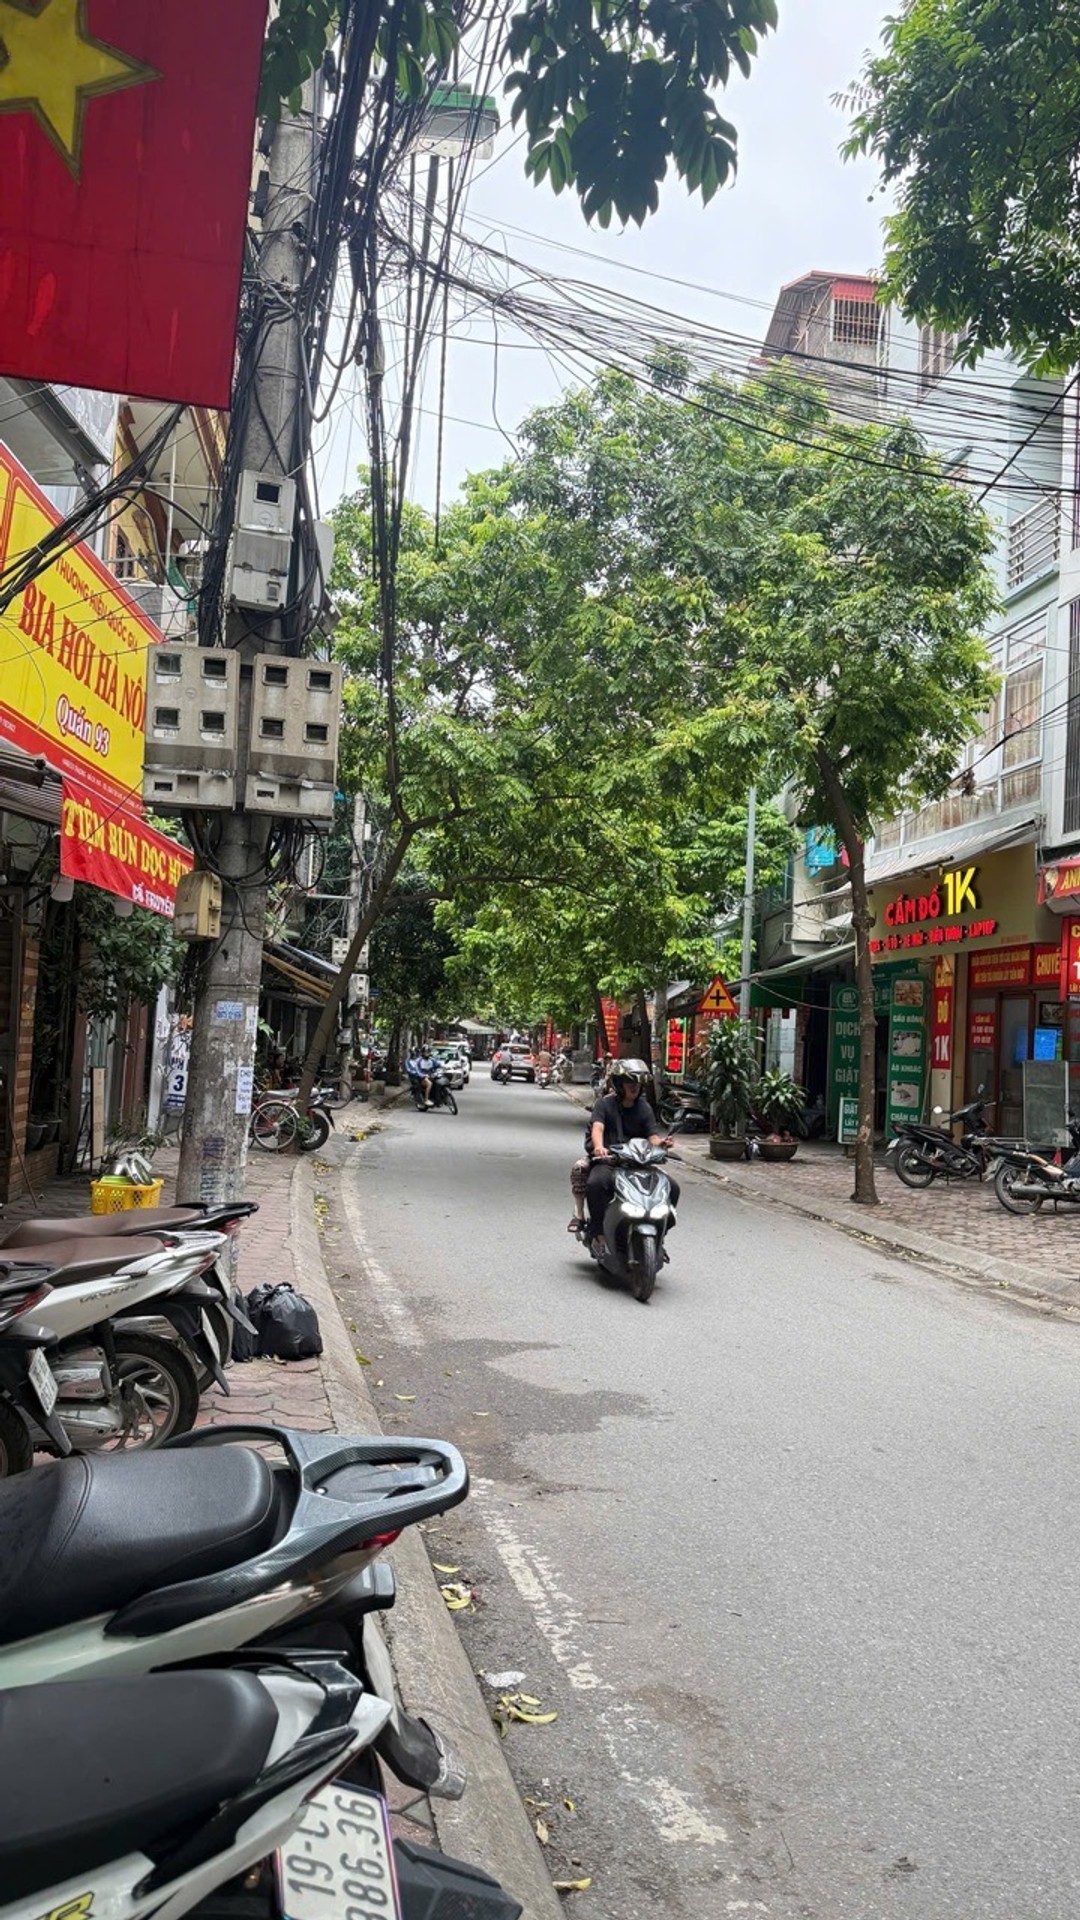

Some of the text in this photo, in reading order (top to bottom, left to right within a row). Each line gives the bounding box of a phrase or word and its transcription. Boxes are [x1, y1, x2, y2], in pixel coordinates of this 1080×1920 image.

[18, 580, 56, 658] BIA
[57, 613, 96, 690] HƠI
[94, 649, 120, 711] HÀ
[56, 694, 93, 748] Quán
[94, 723, 111, 758] 93
[63, 797, 106, 857] TIỆM
[108, 818, 138, 869] BÚN
[140, 839, 167, 886] DỌC
[943, 867, 977, 915] 1K
[969, 919, 996, 937] LAPTOP
[835, 1021, 861, 1038] DỊCH
[840, 1045, 855, 1062] VỤ
[934, 1035, 950, 1062] 1K
[173, 1074, 184, 1091] 3
[835, 1066, 859, 1085] GIẶT
